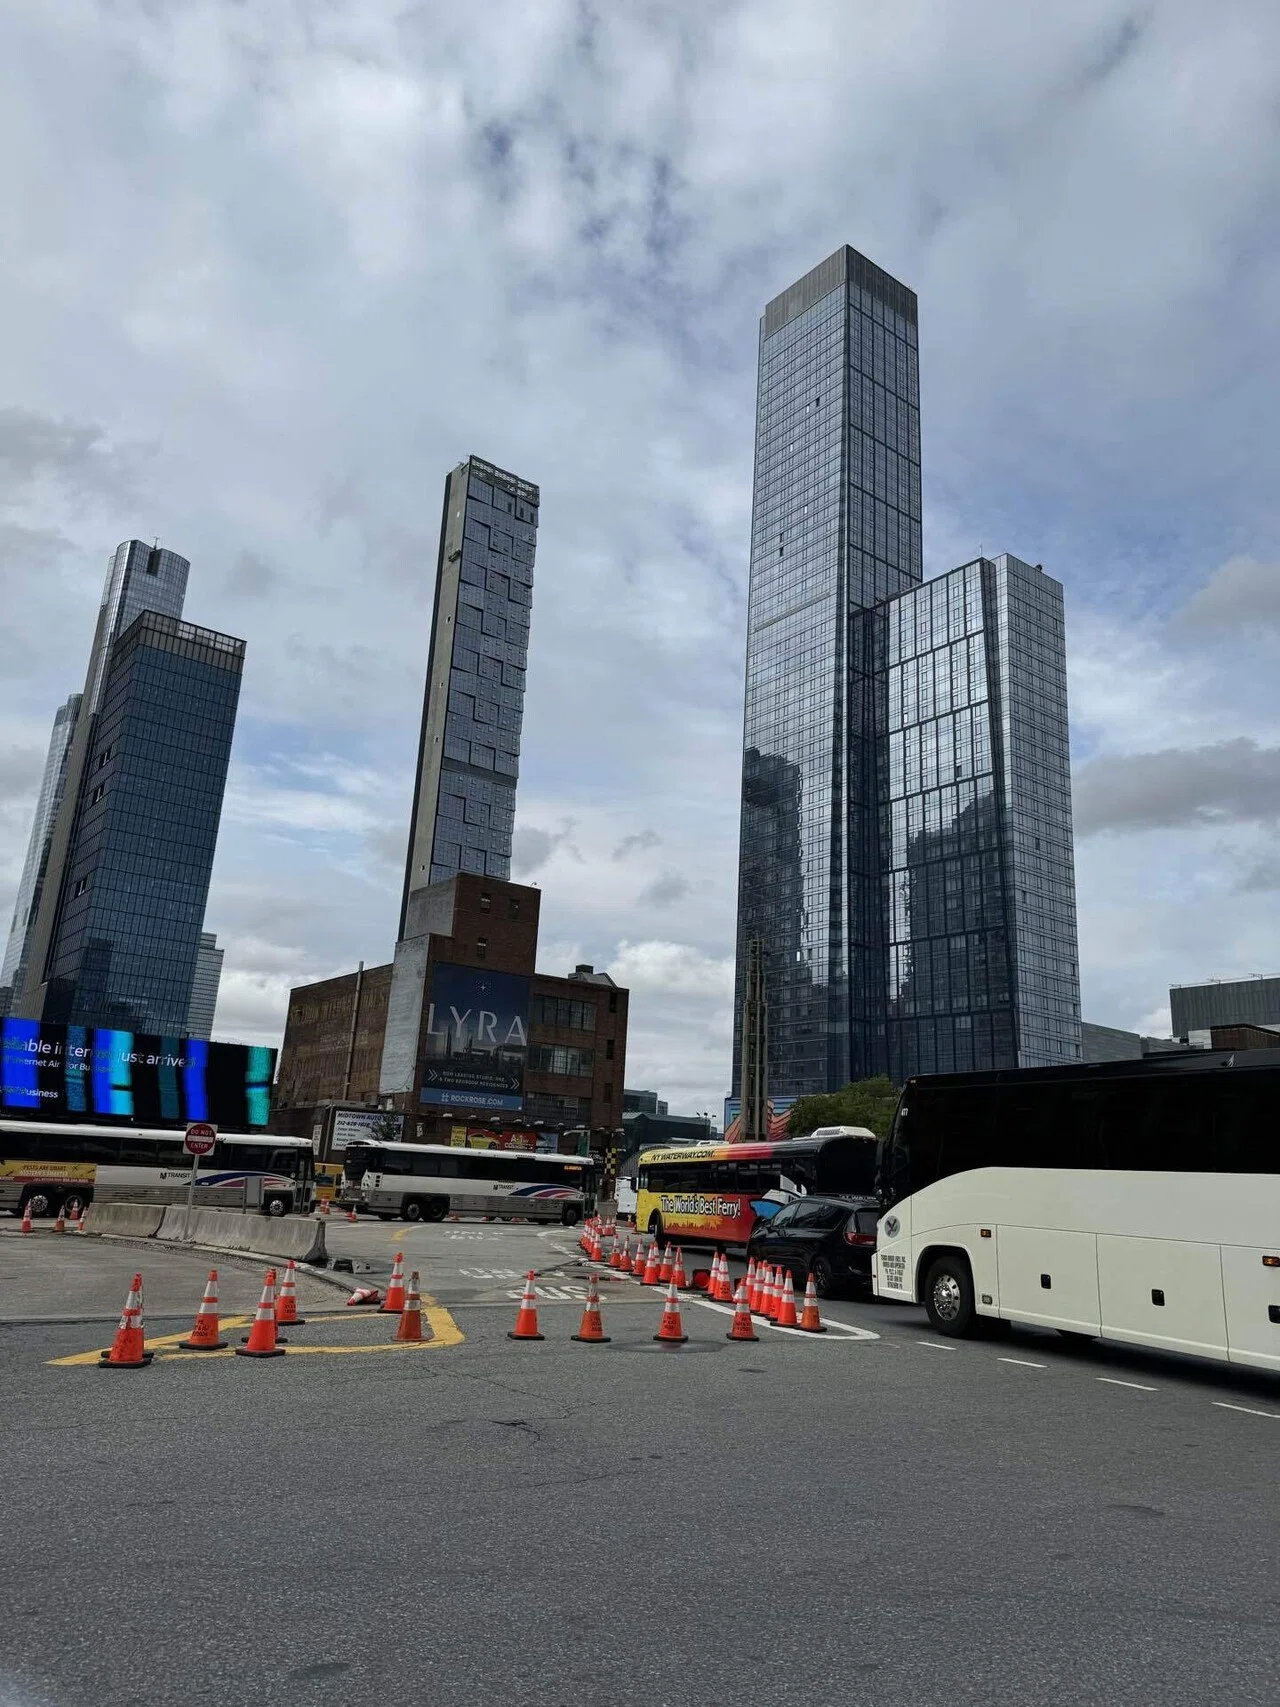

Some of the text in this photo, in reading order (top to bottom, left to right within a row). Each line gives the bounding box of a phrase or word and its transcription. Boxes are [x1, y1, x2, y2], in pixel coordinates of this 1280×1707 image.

[426, 1002, 528, 1047] LYRA
[450, 1094, 504, 1106] ROCKROSE.COM
[337, 1112, 366, 1120] MIDTOWN
[661, 1193, 741, 1219] The World's Best Ferry!
